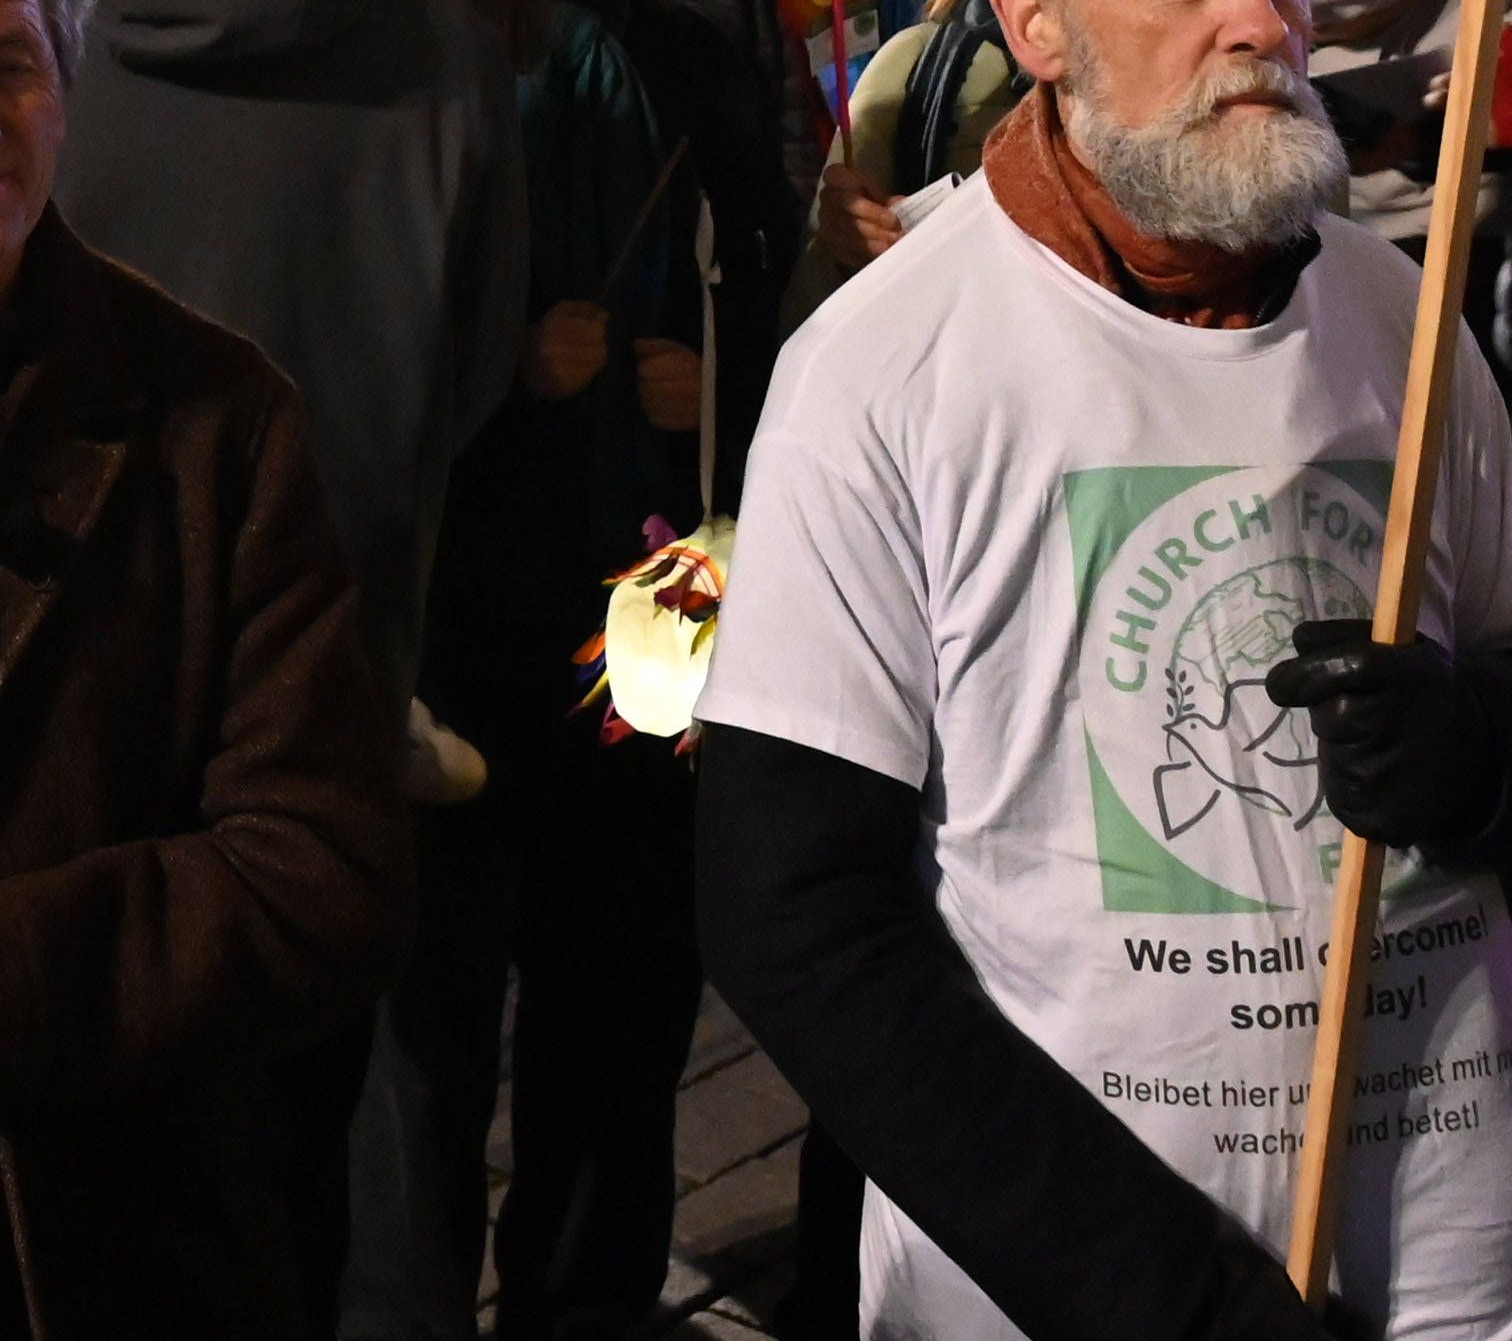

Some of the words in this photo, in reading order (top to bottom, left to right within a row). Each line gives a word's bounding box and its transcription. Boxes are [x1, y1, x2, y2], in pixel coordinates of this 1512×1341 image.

[1105, 493, 1273, 693] CHURCH
[1299, 490, 1374, 567] FOR
[1124, 937, 1192, 974] We
[1206, 936, 1305, 975] shall
[1230, 999, 1320, 1031] som
[1102, 1071, 1212, 1108] Bleibet
[1221, 1079, 1280, 1107] hier
[1452, 1050, 1493, 1082] mit
[1214, 1127, 1304, 1156] wach
[1399, 1100, 1480, 1138] betet!
